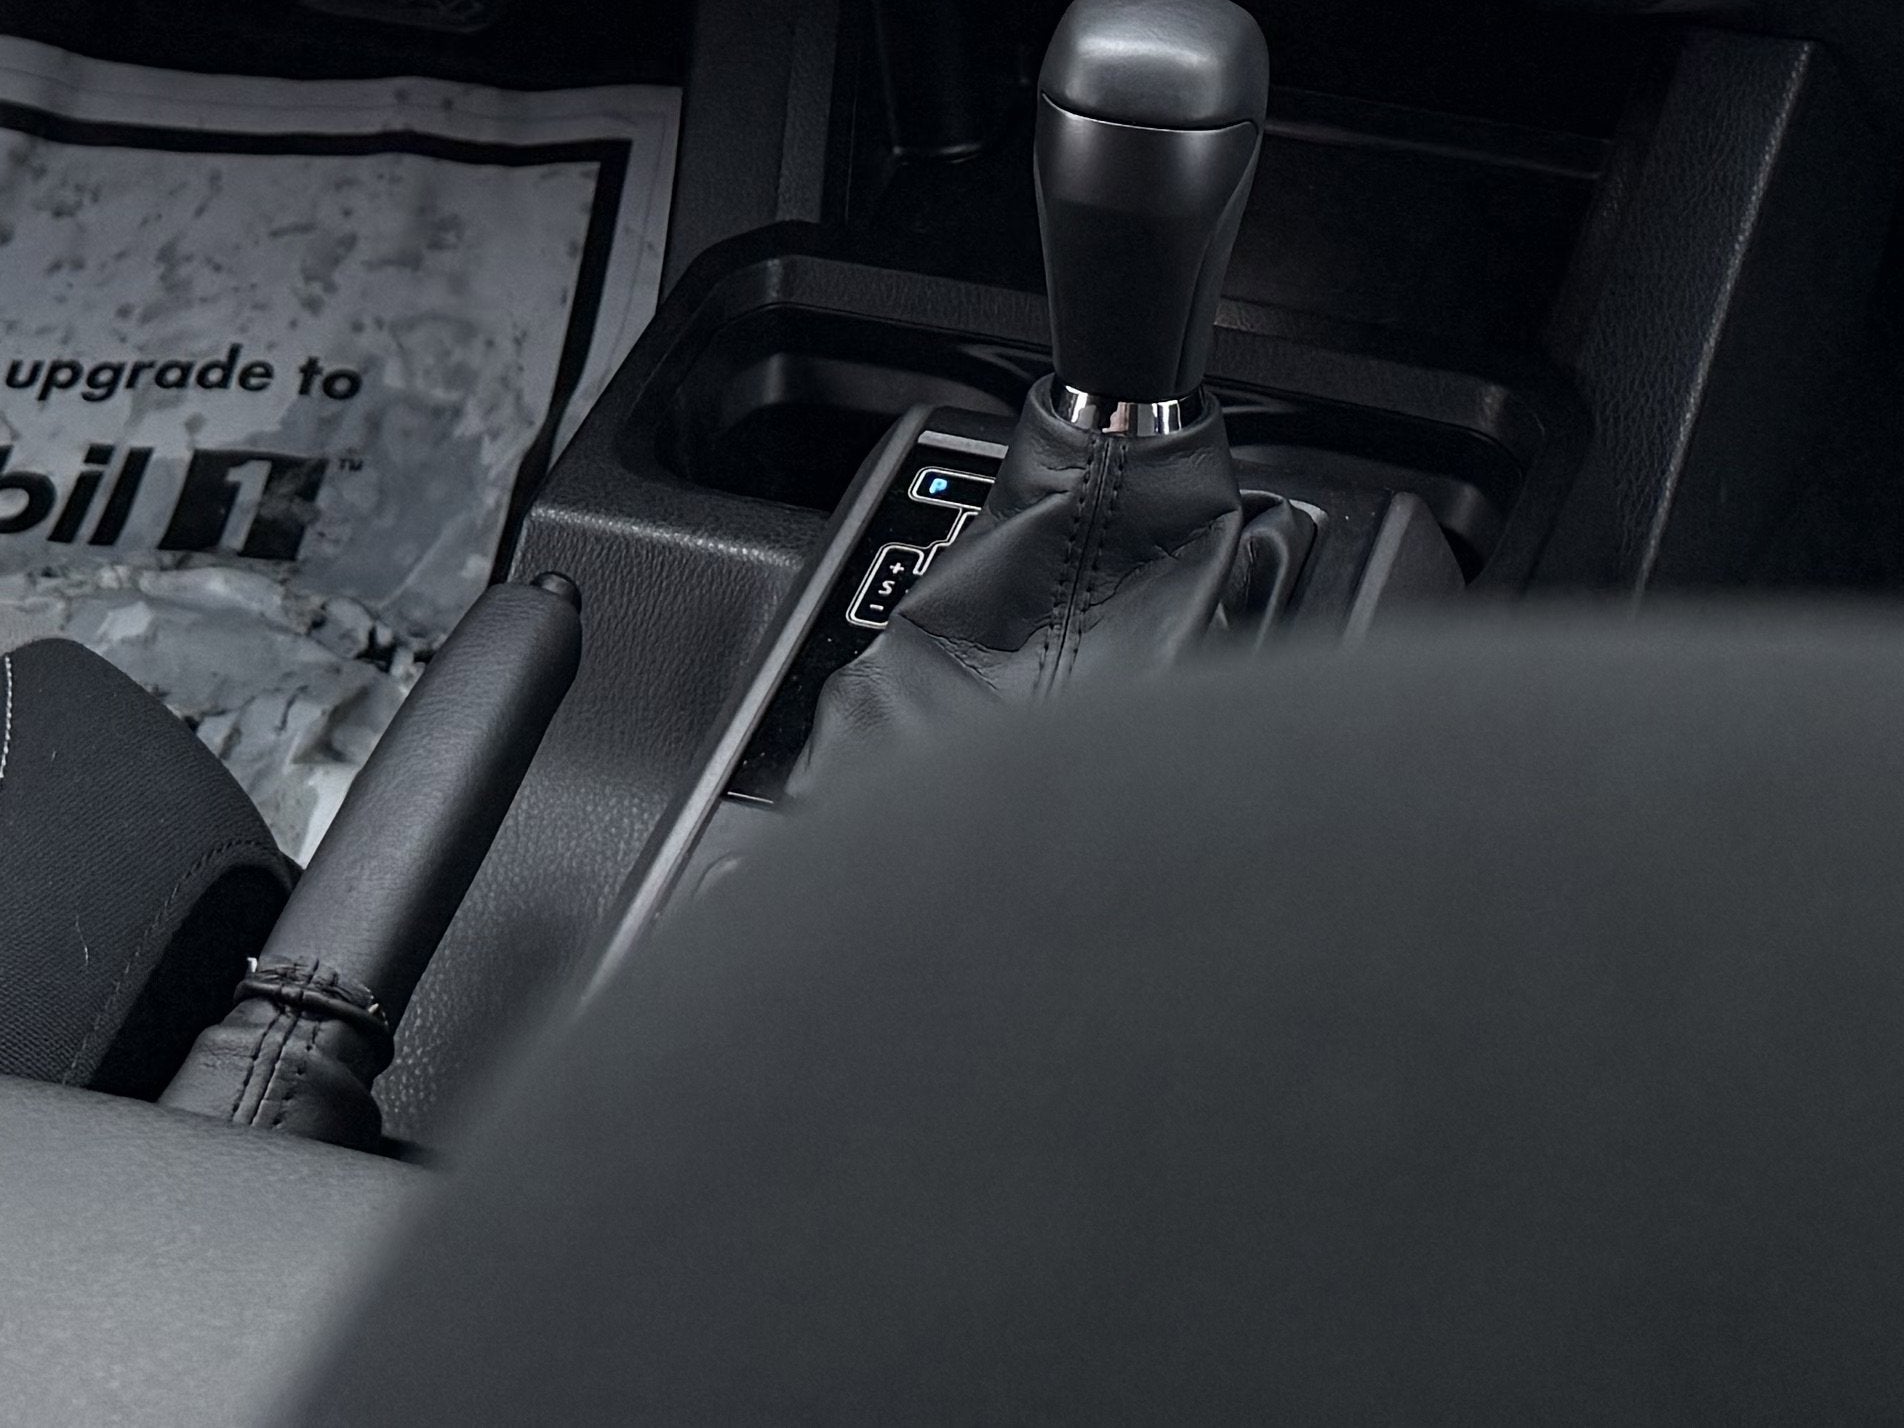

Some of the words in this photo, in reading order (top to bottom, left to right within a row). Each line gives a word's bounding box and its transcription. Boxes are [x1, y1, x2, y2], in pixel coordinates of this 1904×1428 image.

[4, 344, 274, 402] upgrade
[299, 356, 363, 401] to
[929, 478, 947, 494] P
[878, 580, 895, 594] S
